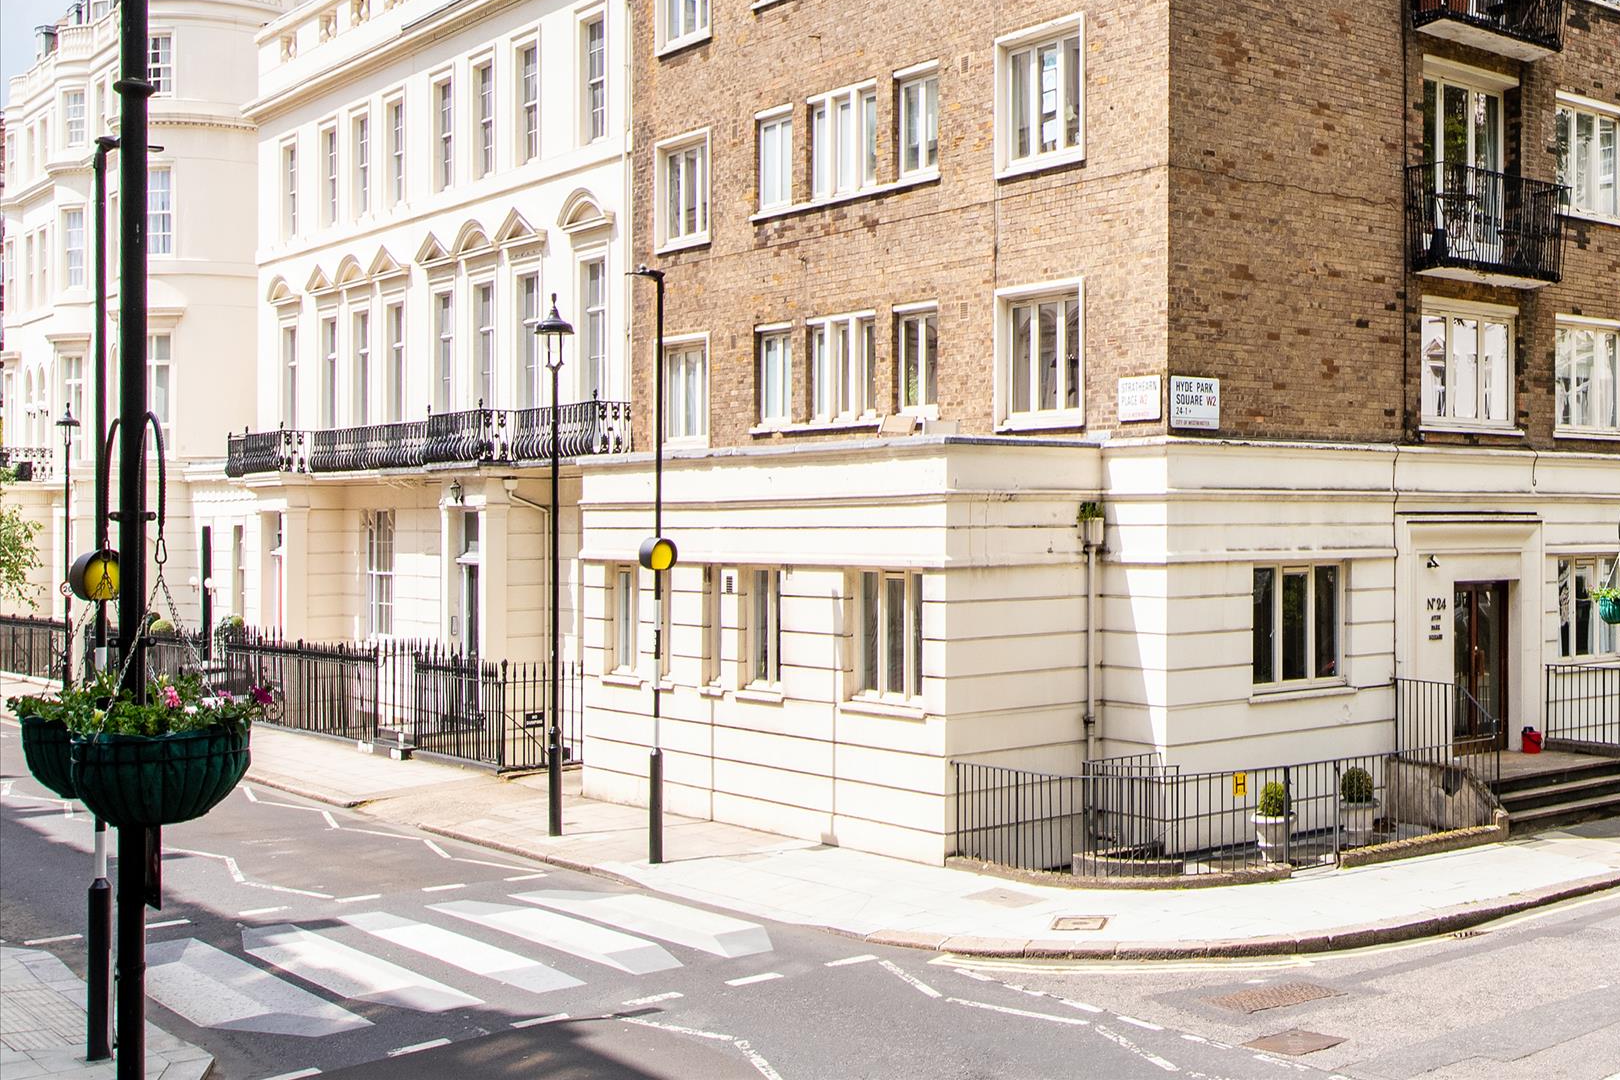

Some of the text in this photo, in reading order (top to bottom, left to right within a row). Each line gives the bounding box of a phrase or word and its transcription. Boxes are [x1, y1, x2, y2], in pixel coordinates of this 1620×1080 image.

[1175, 381, 1213, 393] HYDE PARK
[1176, 394, 1216, 407] SQUARE W2
[1235, 775, 1246, 794] H
